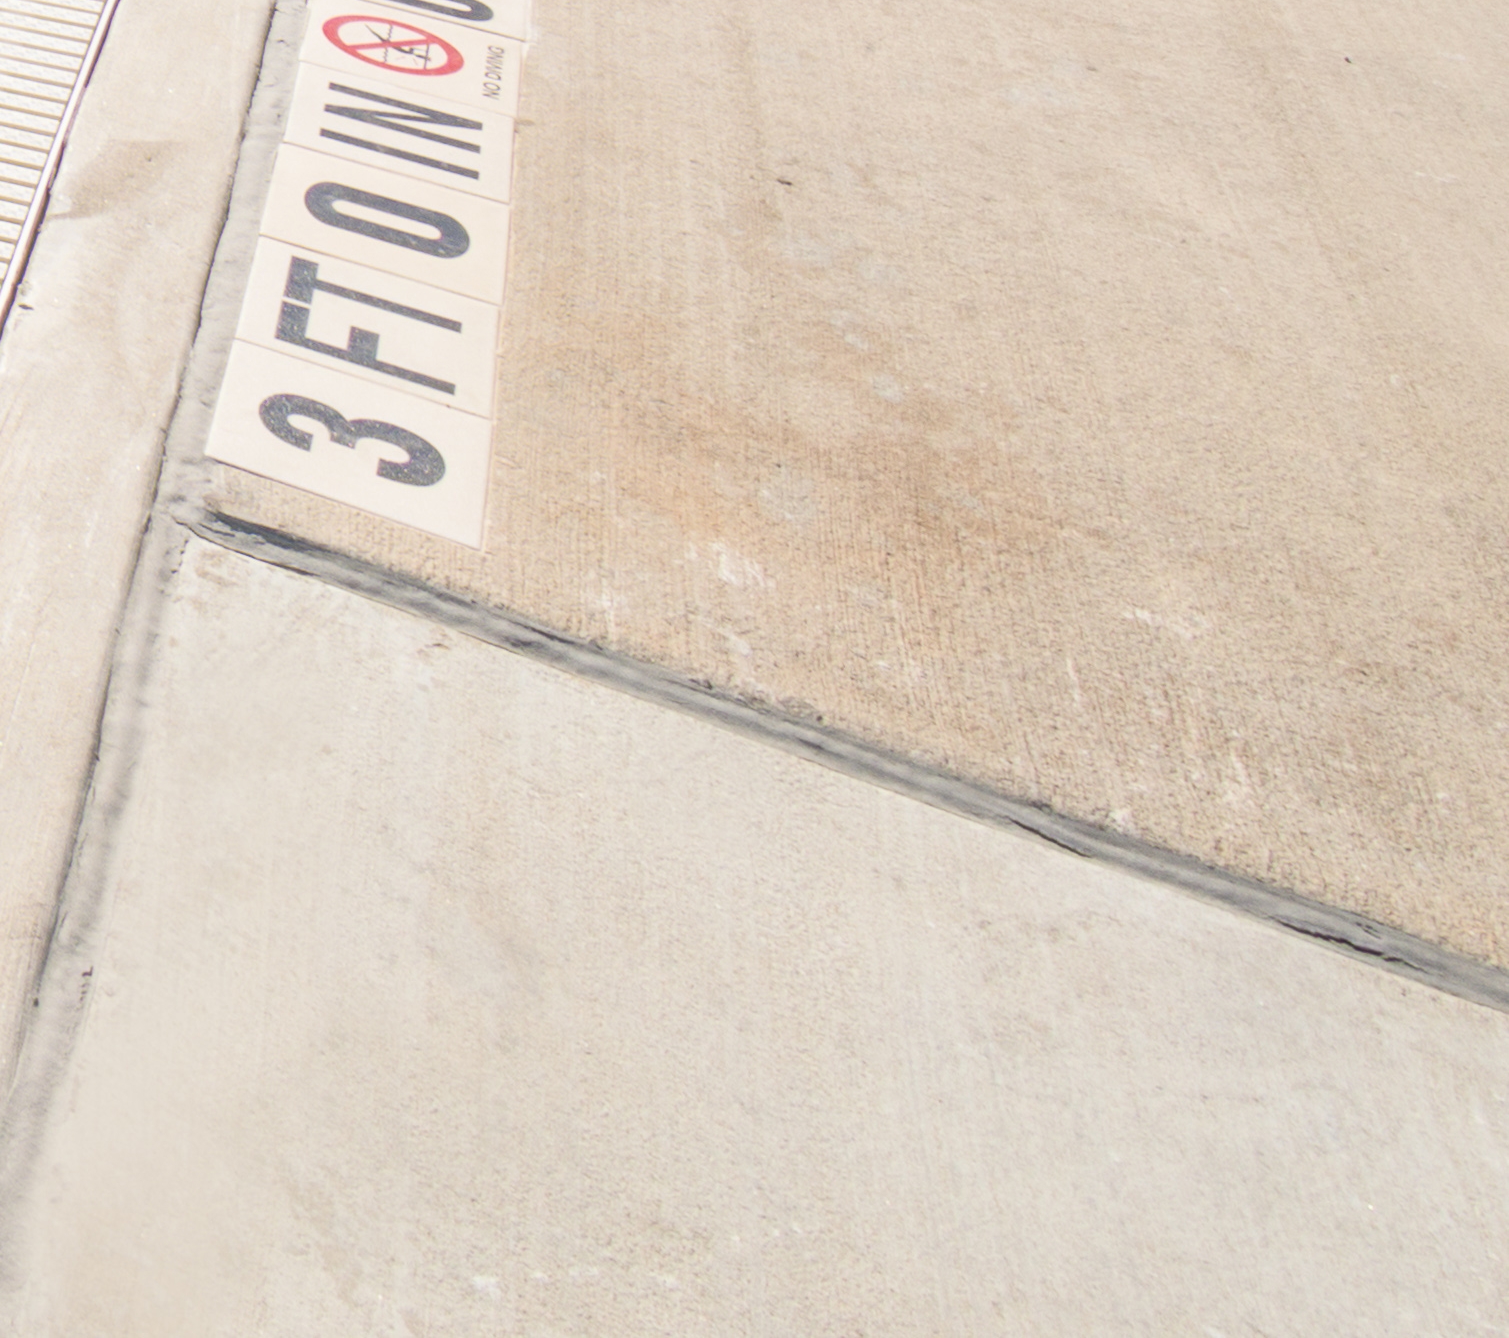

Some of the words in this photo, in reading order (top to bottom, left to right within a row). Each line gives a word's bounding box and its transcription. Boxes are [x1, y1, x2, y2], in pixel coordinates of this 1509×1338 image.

[482, 81, 502, 101] NO
[484, 44, 505, 81] DIVING
[319, 81, 484, 181] IN
[274, 255, 463, 397] FT
[258, 392, 446, 489] 3
